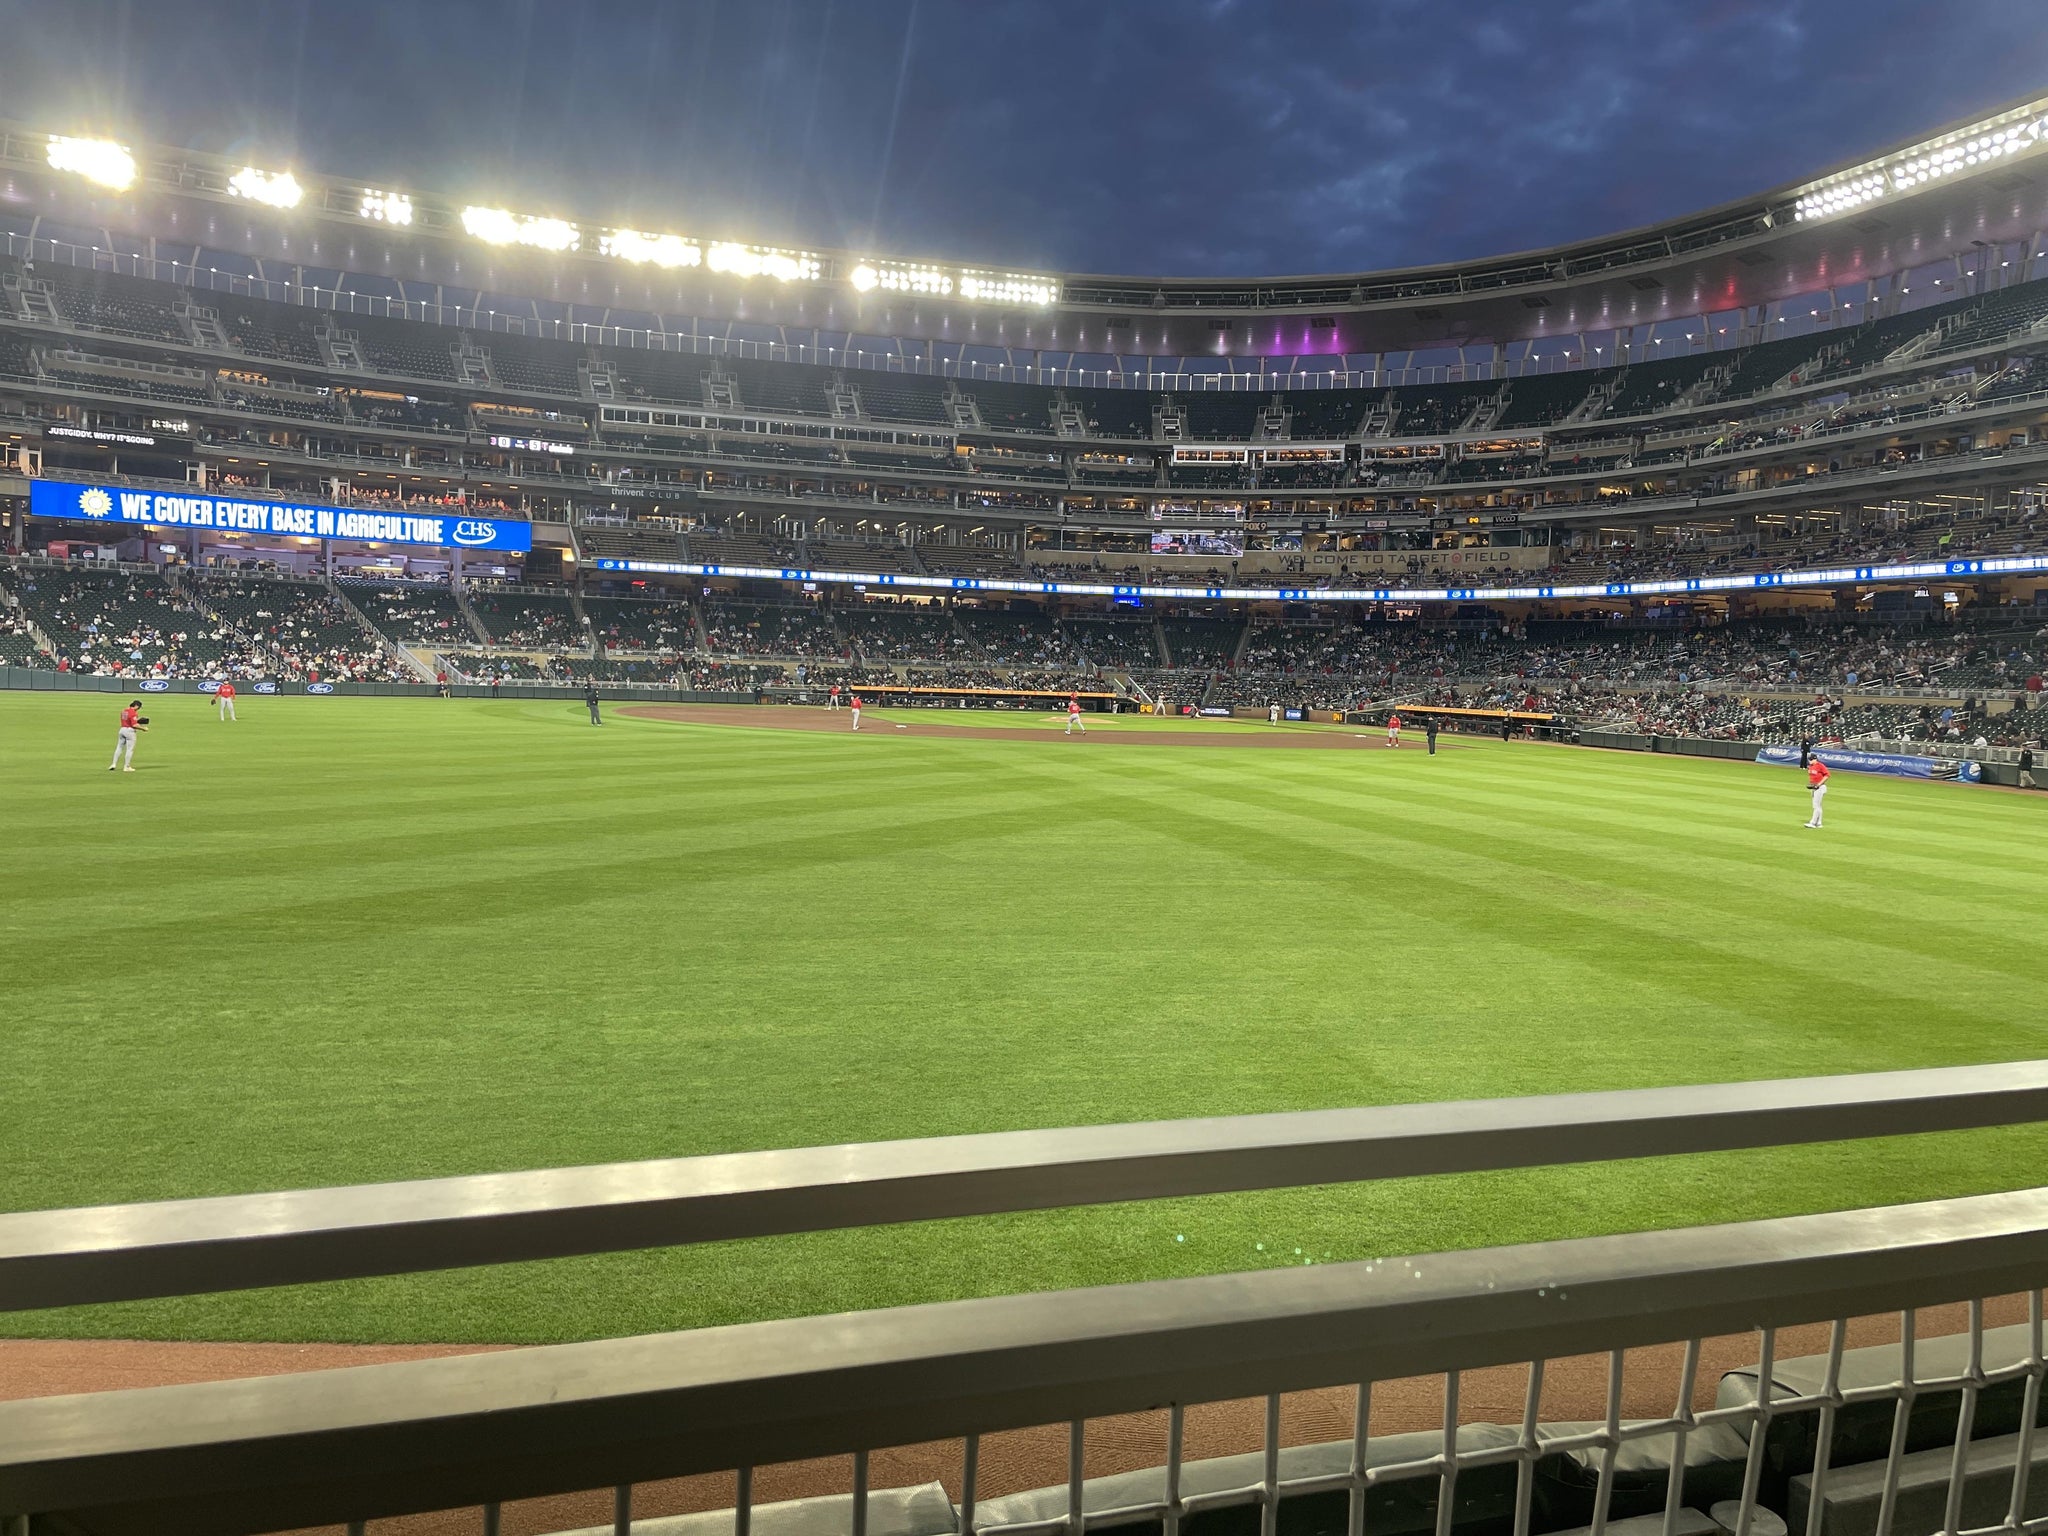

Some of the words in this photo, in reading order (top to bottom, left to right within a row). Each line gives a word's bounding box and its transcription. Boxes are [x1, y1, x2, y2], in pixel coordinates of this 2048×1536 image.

[94, 432, 116, 441] WHY?
[611, 487, 644, 497] thrivent
[120, 493, 152, 520] WE
[154, 496, 213, 527] COVER
[216, 501, 269, 530] EVERY
[271, 506, 315, 534] BASE
[317, 510, 335, 535] IN
[336, 512, 444, 543] AGRICULTURE
[457, 520, 493, 537] CHS
[1243, 522, 1260, 530] FOX
[1260, 522, 1267, 530] 9
[1279, 555, 1358, 564] WELCOME
[1363, 555, 1384, 564] TO
[1387, 553, 1450, 563] TARGET
[1464, 551, 1511, 562] FIELD
